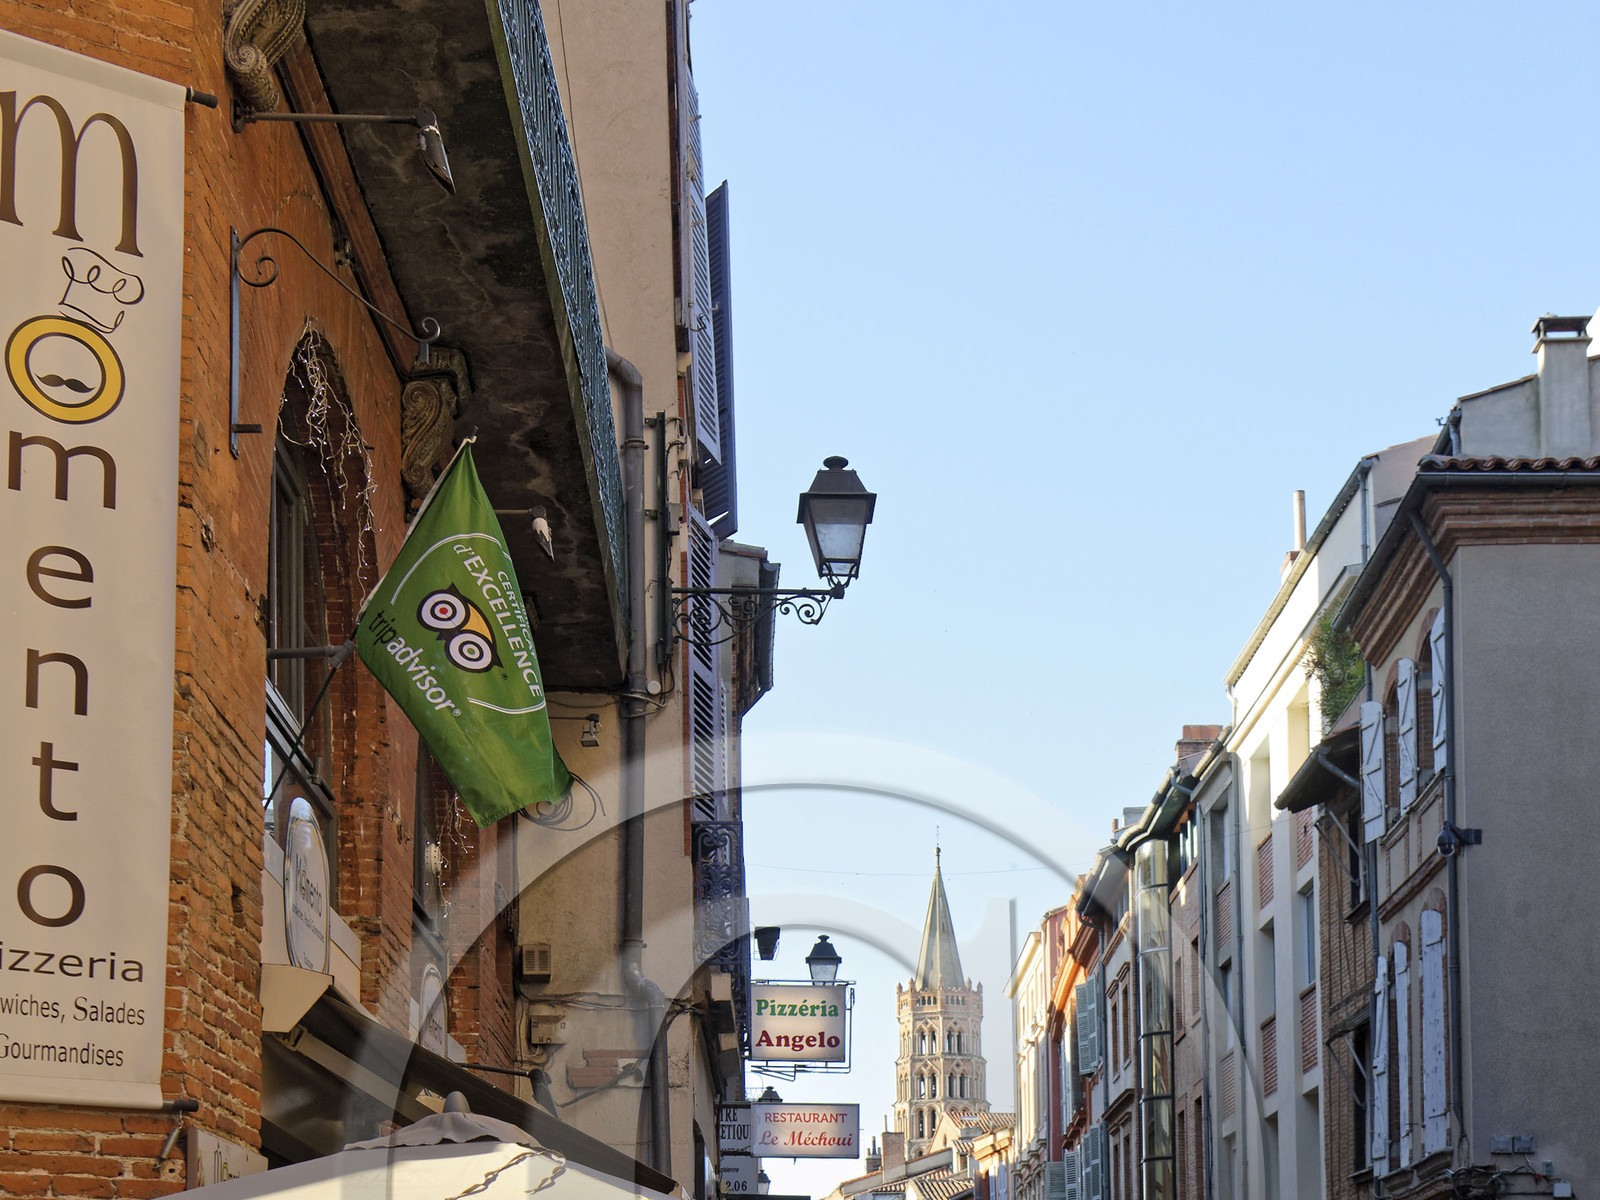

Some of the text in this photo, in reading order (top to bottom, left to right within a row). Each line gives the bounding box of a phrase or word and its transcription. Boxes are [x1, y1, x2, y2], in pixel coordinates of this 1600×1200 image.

[452, 544, 544, 697] d'EXCELLENCE
[73, 996, 145, 1025] Salades
[755, 999, 839, 1017] Pizzéria
[755, 1029, 840, 1052] Angelo
[764, 1112, 847, 1123] RESTAURANT
[758, 1129, 853, 1147] Le Méchoui
